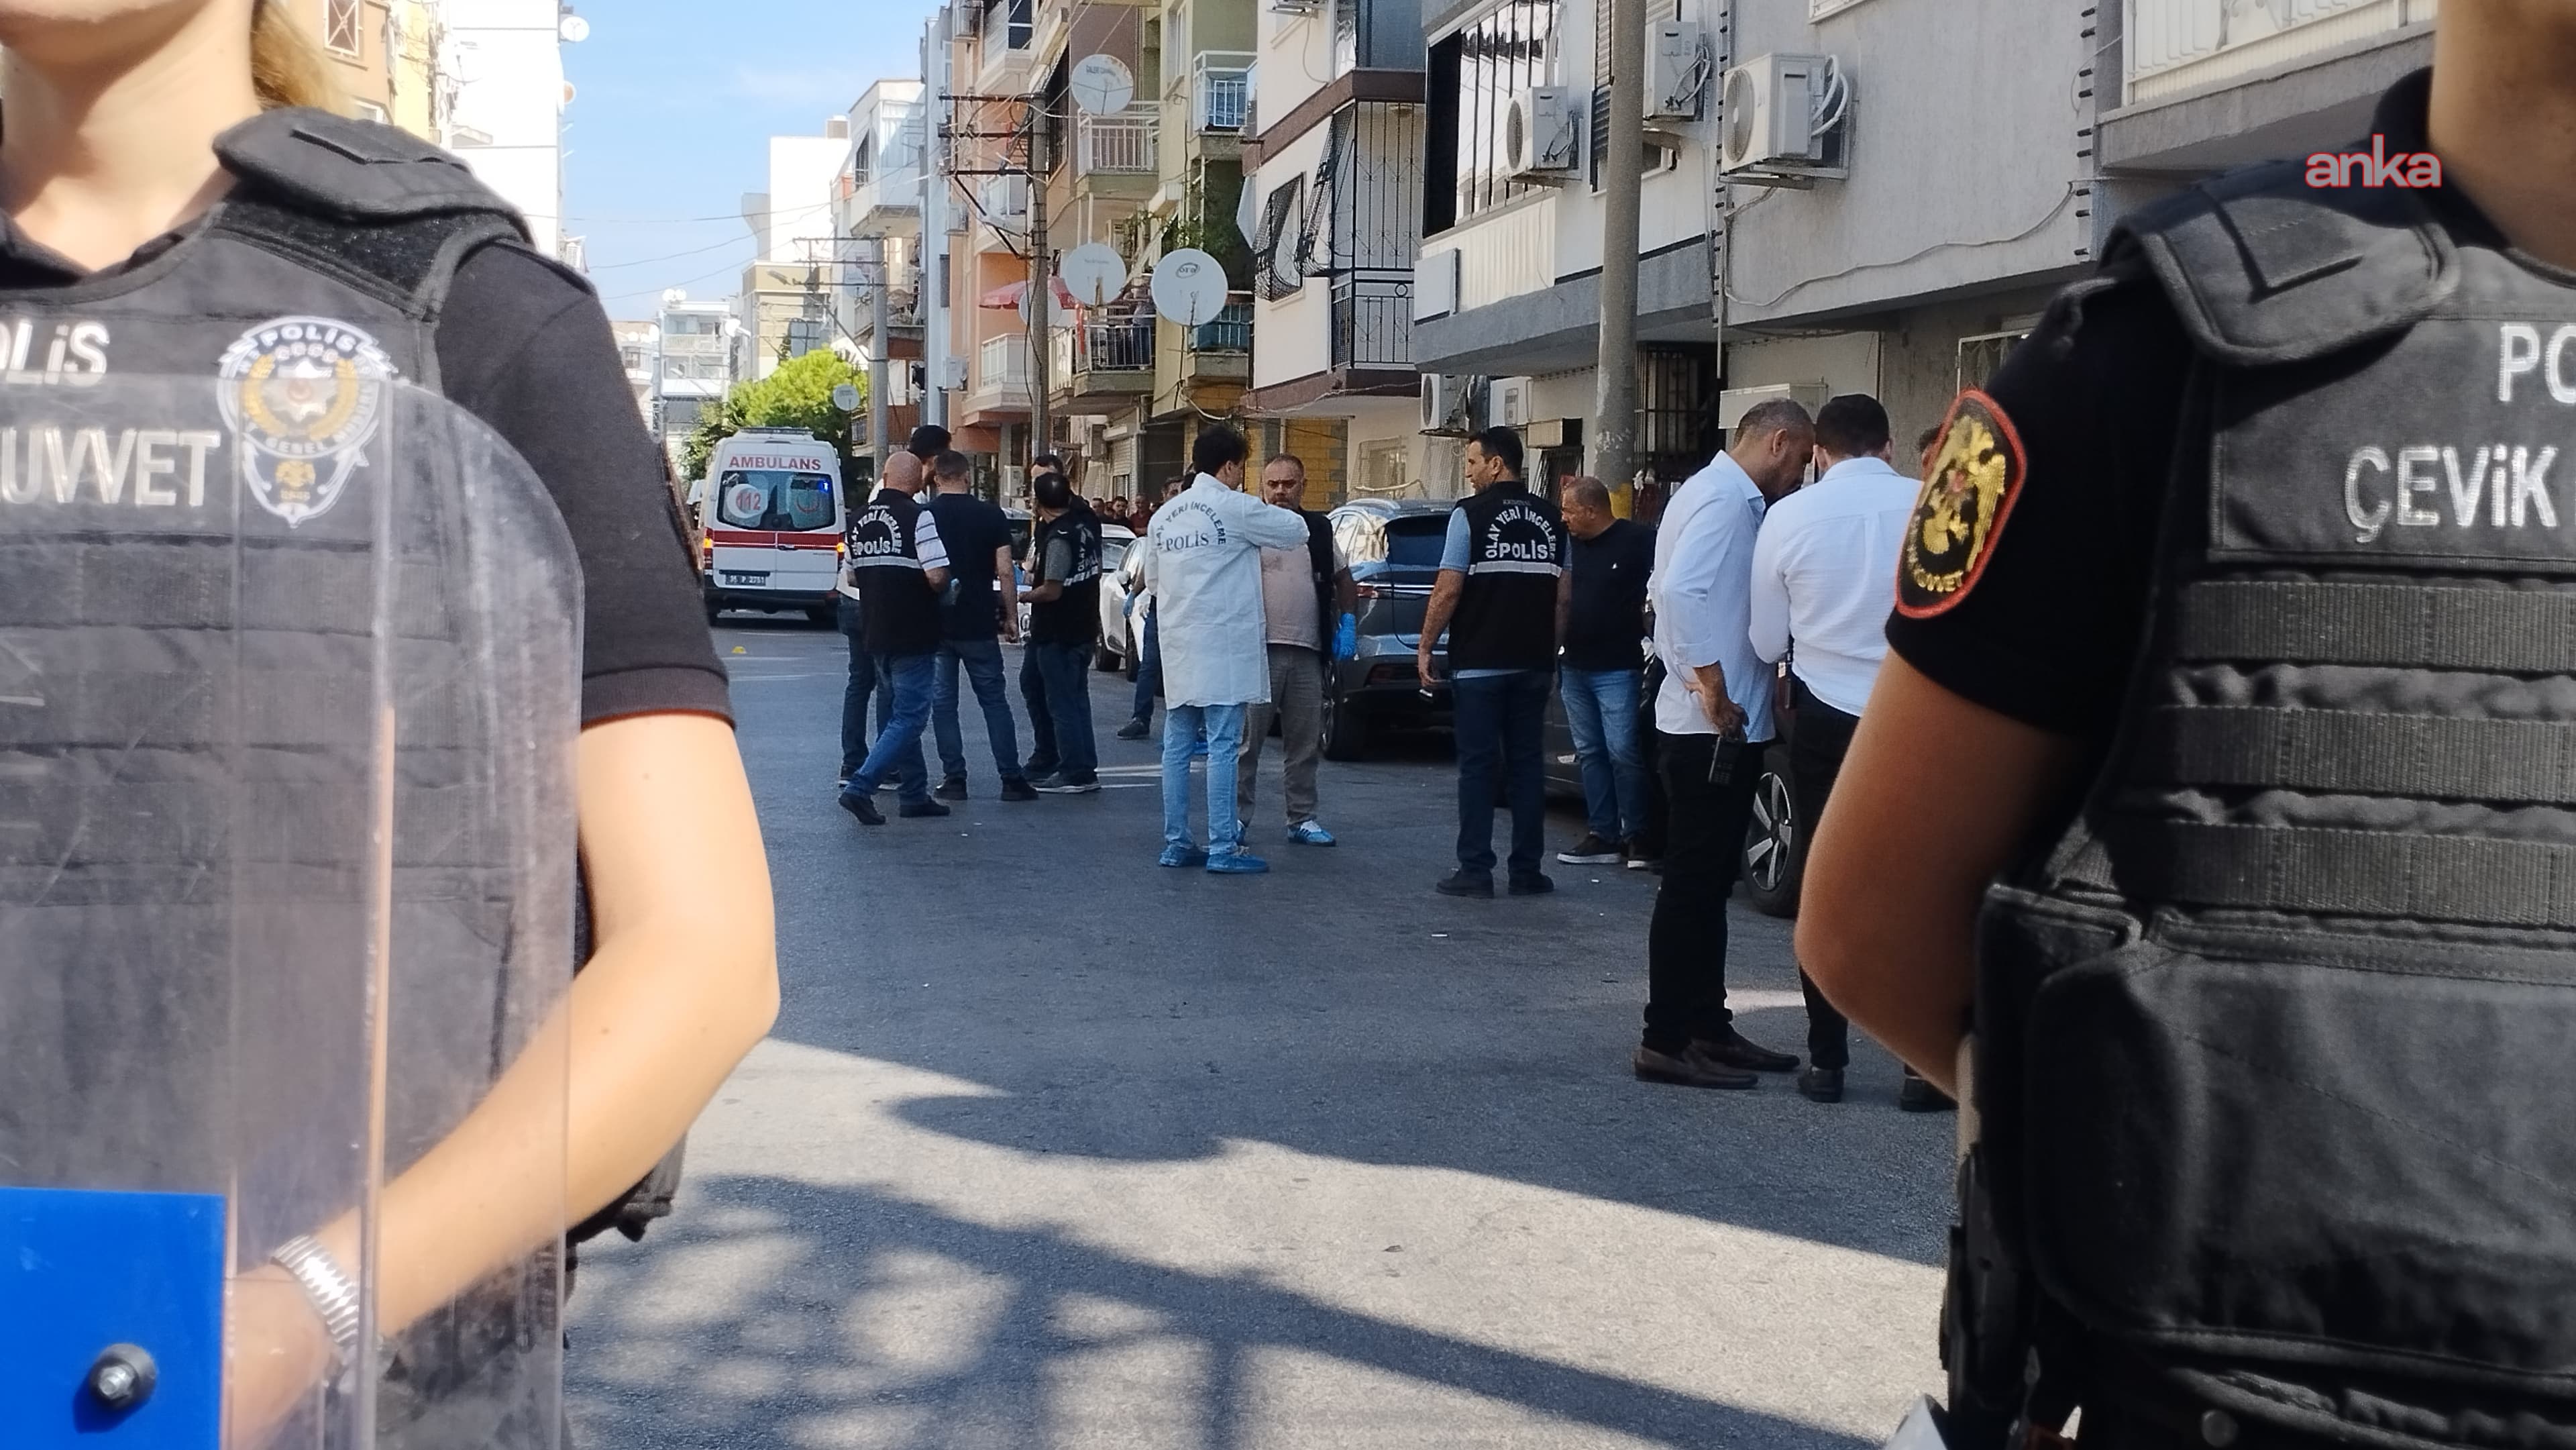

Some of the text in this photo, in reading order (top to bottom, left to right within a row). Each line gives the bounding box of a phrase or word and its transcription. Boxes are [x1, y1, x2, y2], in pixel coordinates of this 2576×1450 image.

[729, 456, 821, 470] AMBULANS
[736, 492, 761, 511] 112
[1166, 530, 1210, 551] POLİS
[1485, 523, 1501, 558] OLAY
